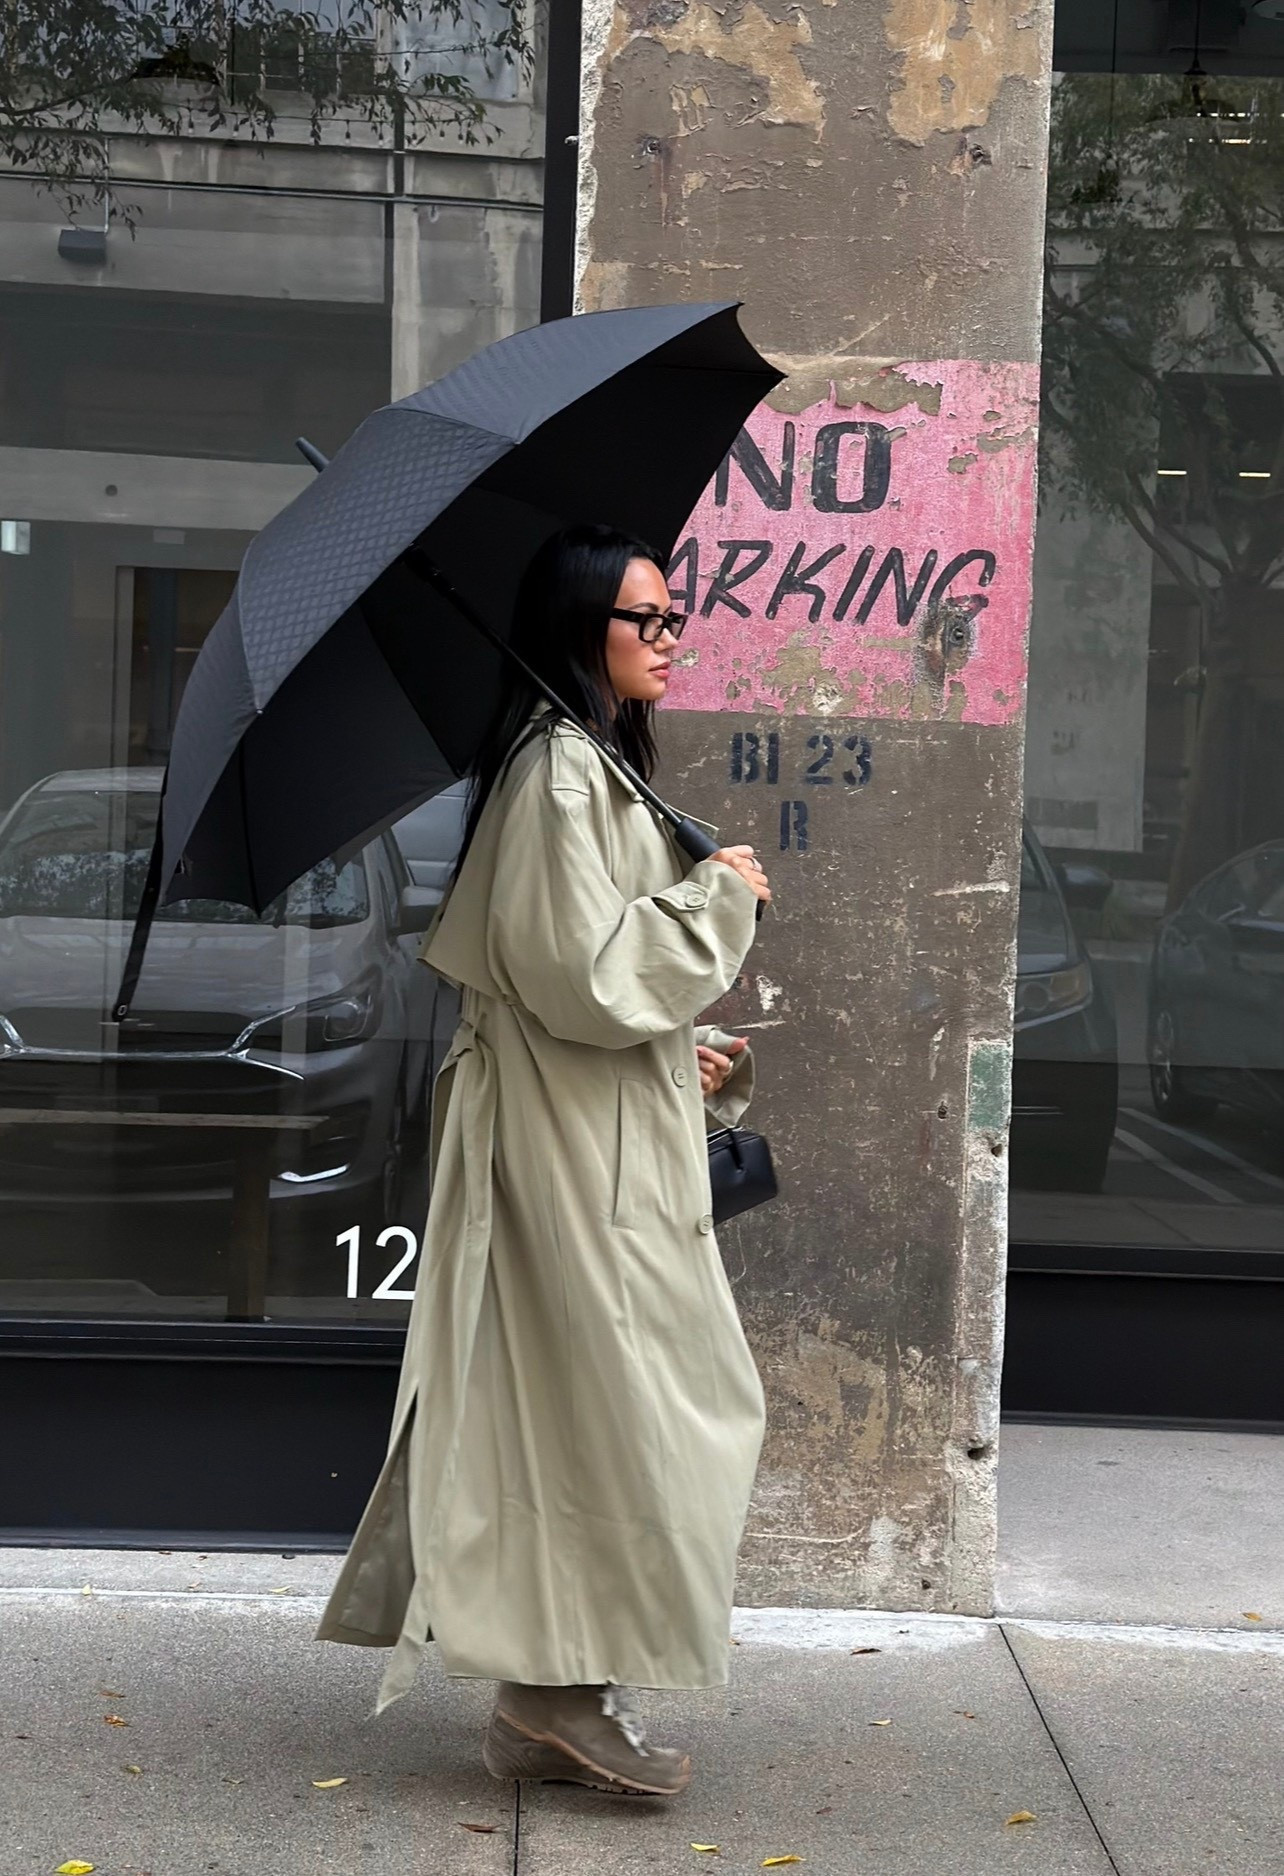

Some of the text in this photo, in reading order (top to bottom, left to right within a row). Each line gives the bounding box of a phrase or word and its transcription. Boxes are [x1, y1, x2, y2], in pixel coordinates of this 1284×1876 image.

[714, 421, 891, 513] NO
[664, 537, 996, 625] ARKING
[805, 734, 873, 786] 23
[779, 800, 809, 851] R
[335, 1224, 418, 1300] 12
